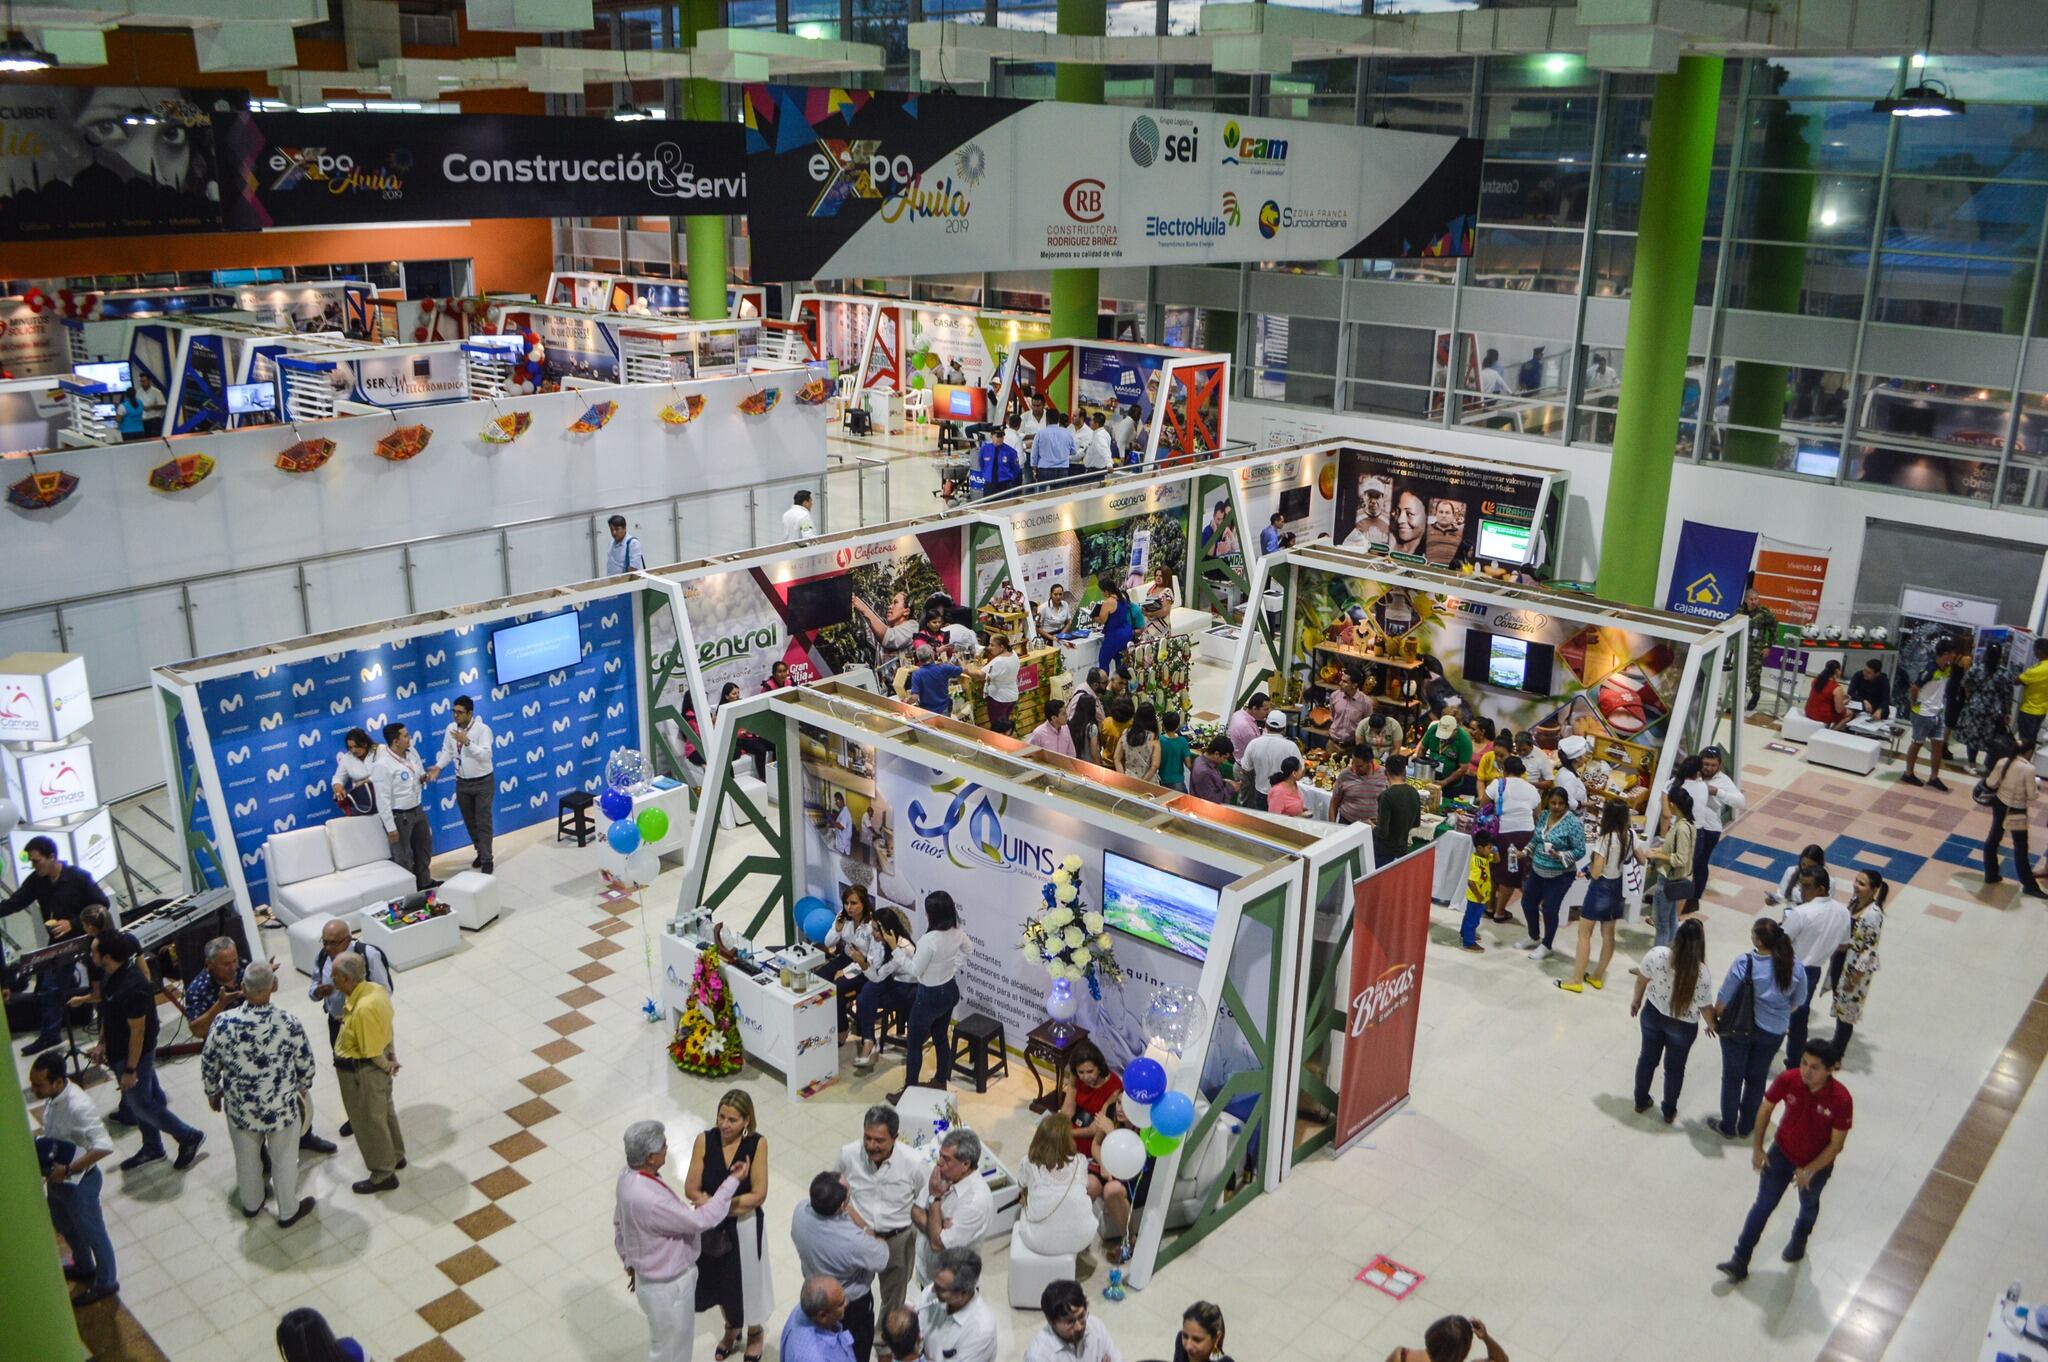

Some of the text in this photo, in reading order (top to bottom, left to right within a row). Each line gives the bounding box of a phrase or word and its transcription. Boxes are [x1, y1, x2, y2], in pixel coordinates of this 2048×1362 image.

[1165, 126, 1199, 163] sei
[1239, 137, 1289, 160] cam
[443, 153, 663, 182] Construcción
[676, 173, 747, 198] Servi
[1282, 207, 1347, 228] Surcolombiana
[1292, 208, 1348, 218] ZONA FRANCA
[945, 218, 970, 234] 2019
[1046, 224, 1118, 236] CONSTRUCTORA
[1146, 216, 1226, 237] ElectroHuila
[1040, 250, 1072, 259] Mejoramos
[1111, 249, 1123, 257] vida
[933, 318, 959, 329] CASAS
[1419, 472, 1448, 483] importante
[1449, 478, 1460, 486] que
[1505, 476, 1526, 487] valores
[854, 543, 897, 560] Cafeteras
[1812, 564, 1823, 573] 14
[1446, 599, 1488, 616] cam
[1493, 614, 1535, 634] Corazón
[970, 794, 1065, 876] QUINS
[910, 838, 945, 860] años
[967, 959, 1045, 999] Depresores de alcalinidad
[967, 985, 975, 995] de
[974, 989, 993, 1004] aguas
[994, 997, 1025, 1019] residuales
[996, 986, 1011, 1000] para
[1011, 991, 1018, 1000] el
[1351, 963, 1416, 1038] Brisas
[967, 998, 996, 1020] Asistencia
